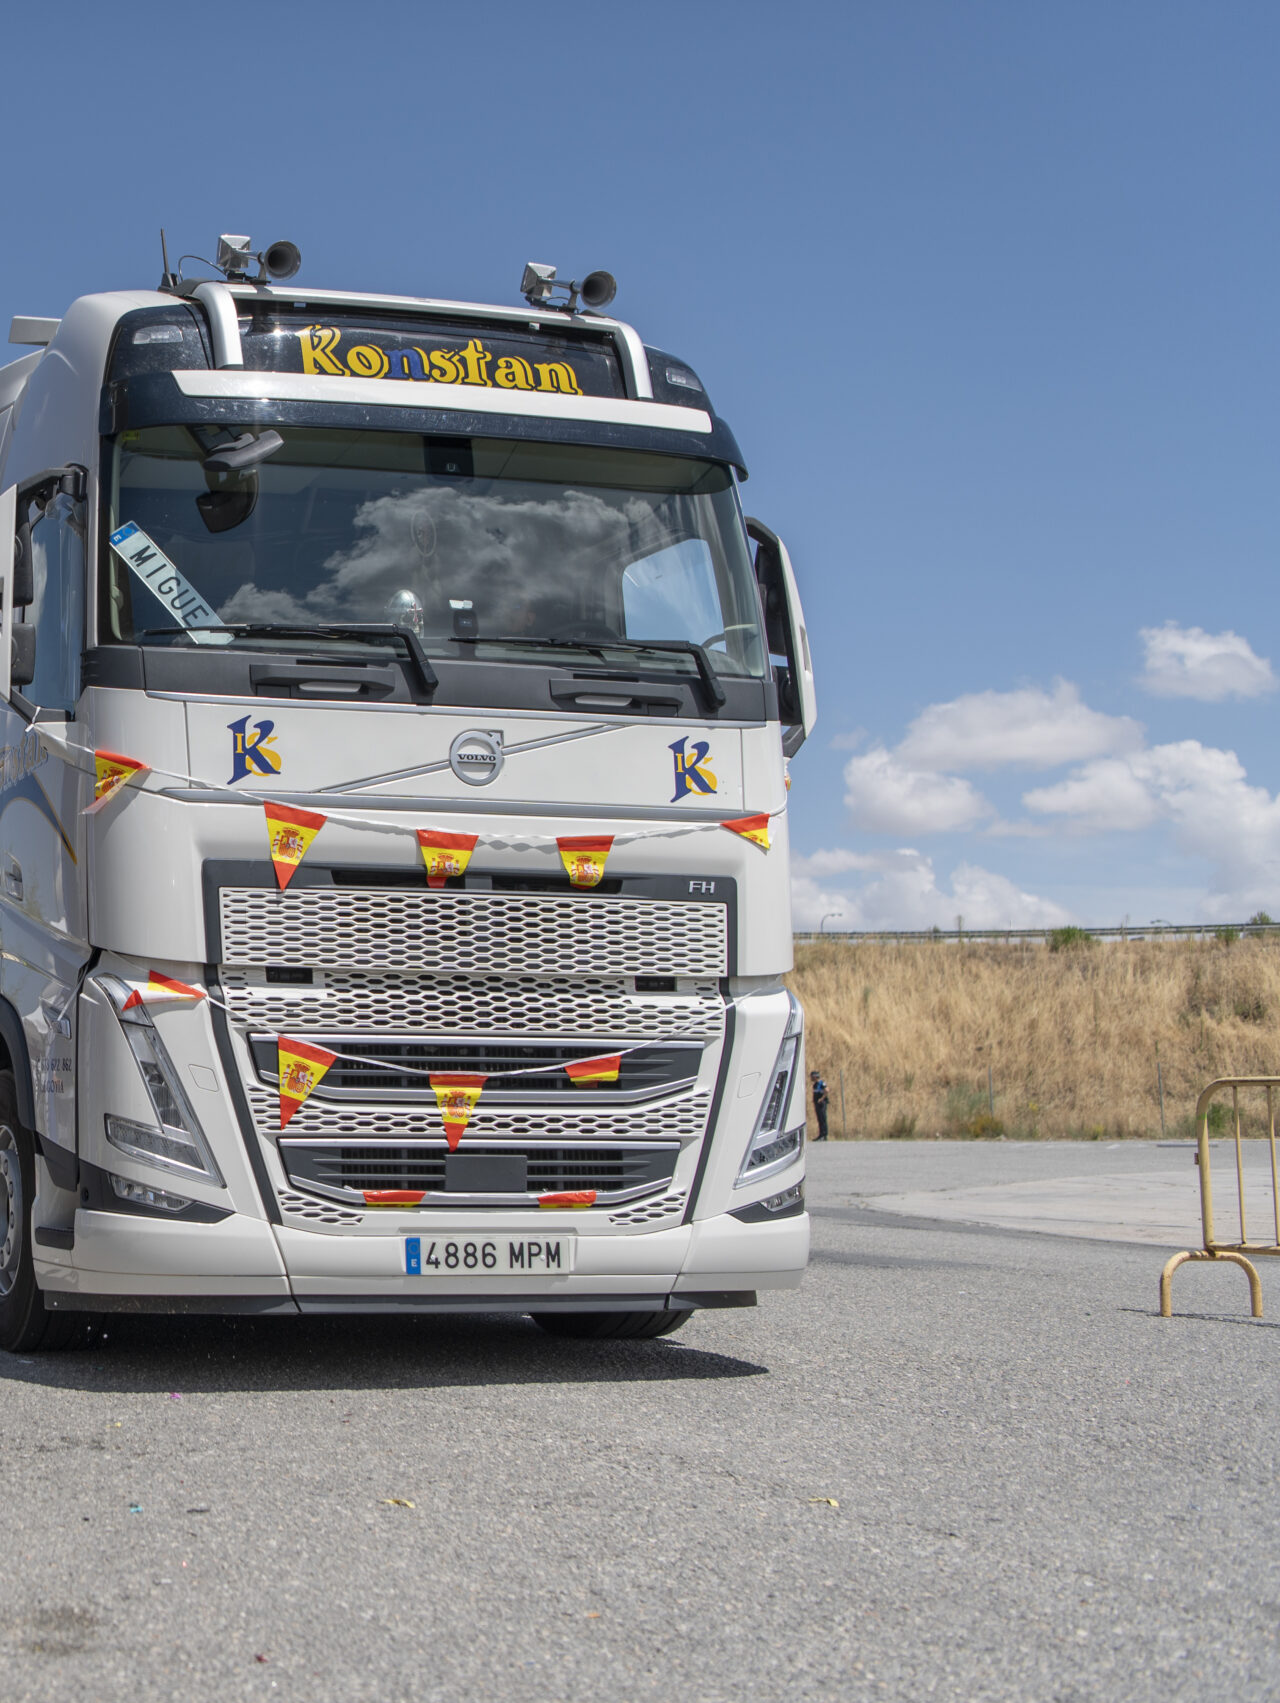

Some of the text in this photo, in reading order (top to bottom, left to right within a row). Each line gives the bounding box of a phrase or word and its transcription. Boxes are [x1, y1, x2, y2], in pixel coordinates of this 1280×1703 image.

[295, 324, 583, 396] Konstan
[129, 544, 210, 628] MIGUE
[457, 754, 497, 762] VOLVO
[688, 880, 716, 894] FH
[410, 1241, 562, 1269] E 4886 MPM
